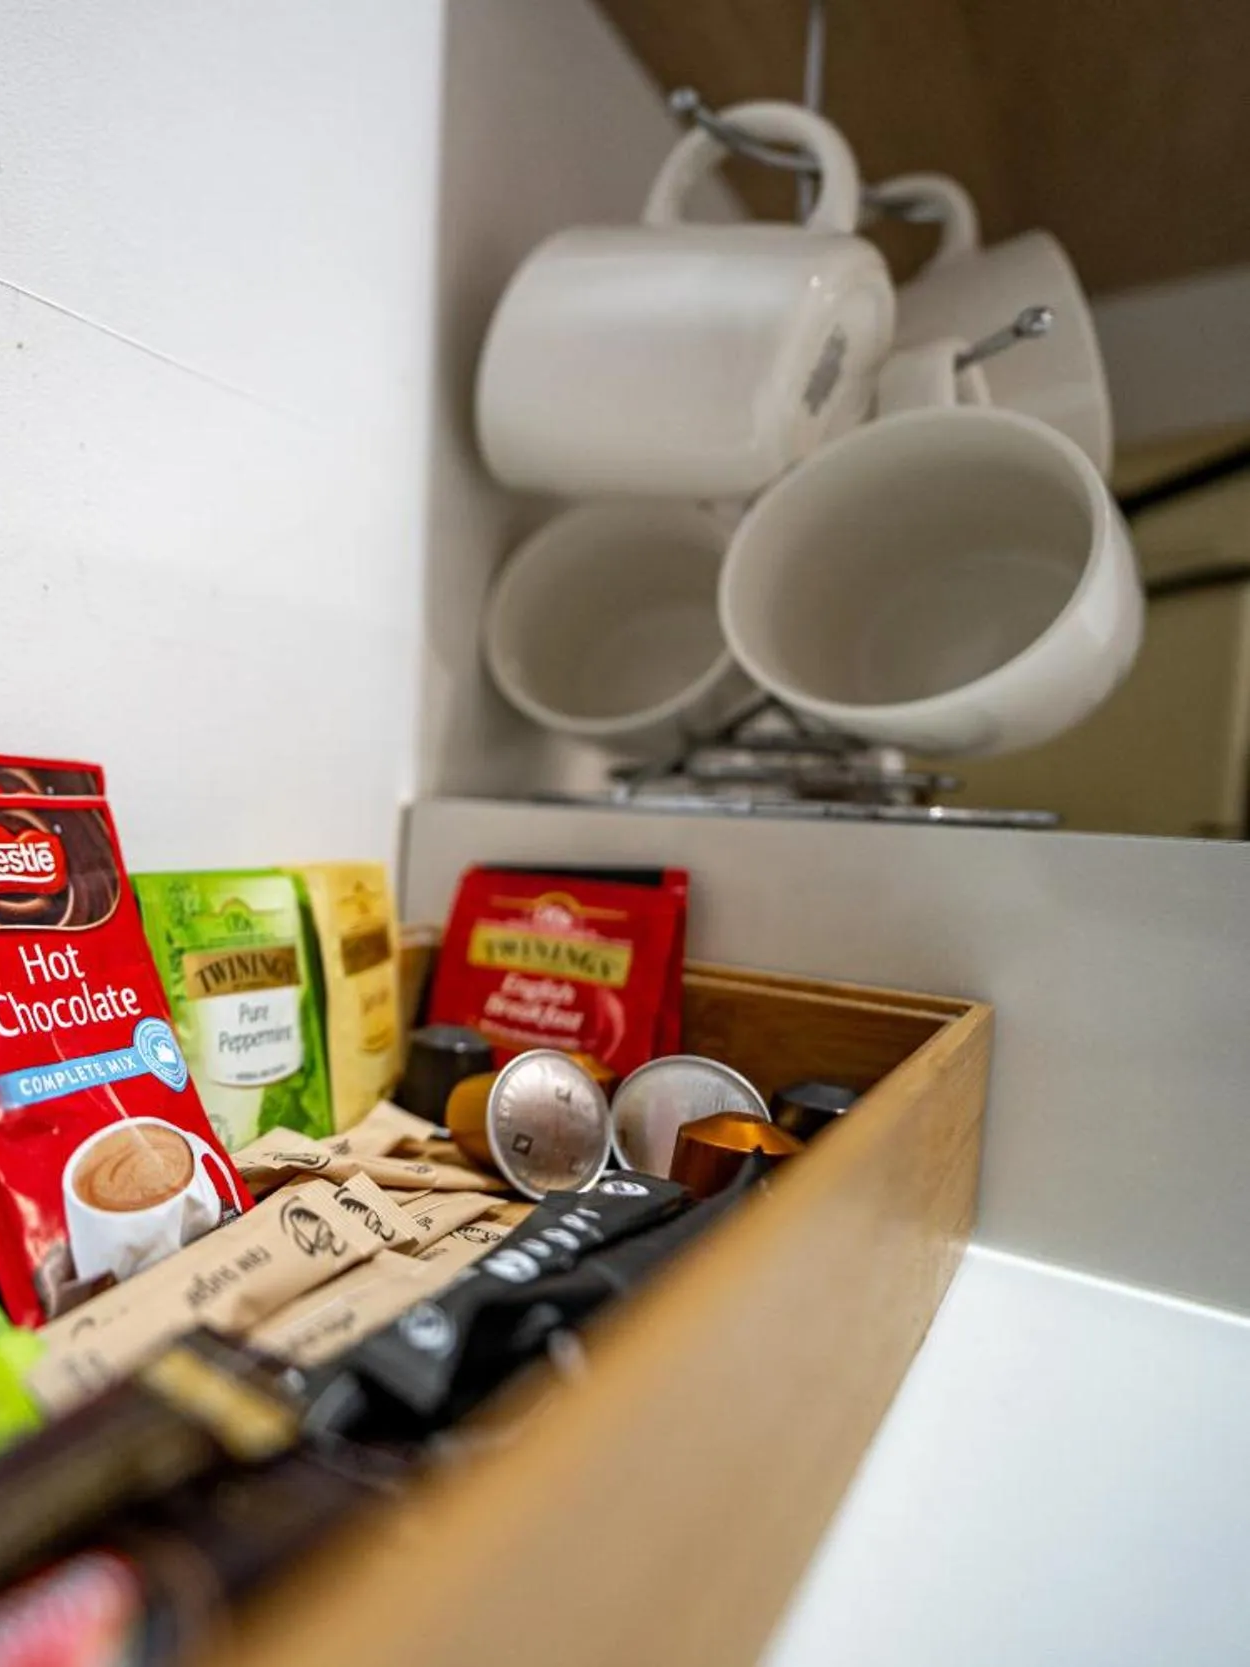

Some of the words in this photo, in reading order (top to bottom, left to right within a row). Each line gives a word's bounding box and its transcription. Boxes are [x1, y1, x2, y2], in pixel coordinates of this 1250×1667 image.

[18, 943, 85, 985] Hot
[238, 1003, 268, 1025] Pure
[218, 1024, 292, 1054] Peppermint
[18, 1060, 106, 1097] COMPLETE
[108, 1055, 137, 1075] MIX
